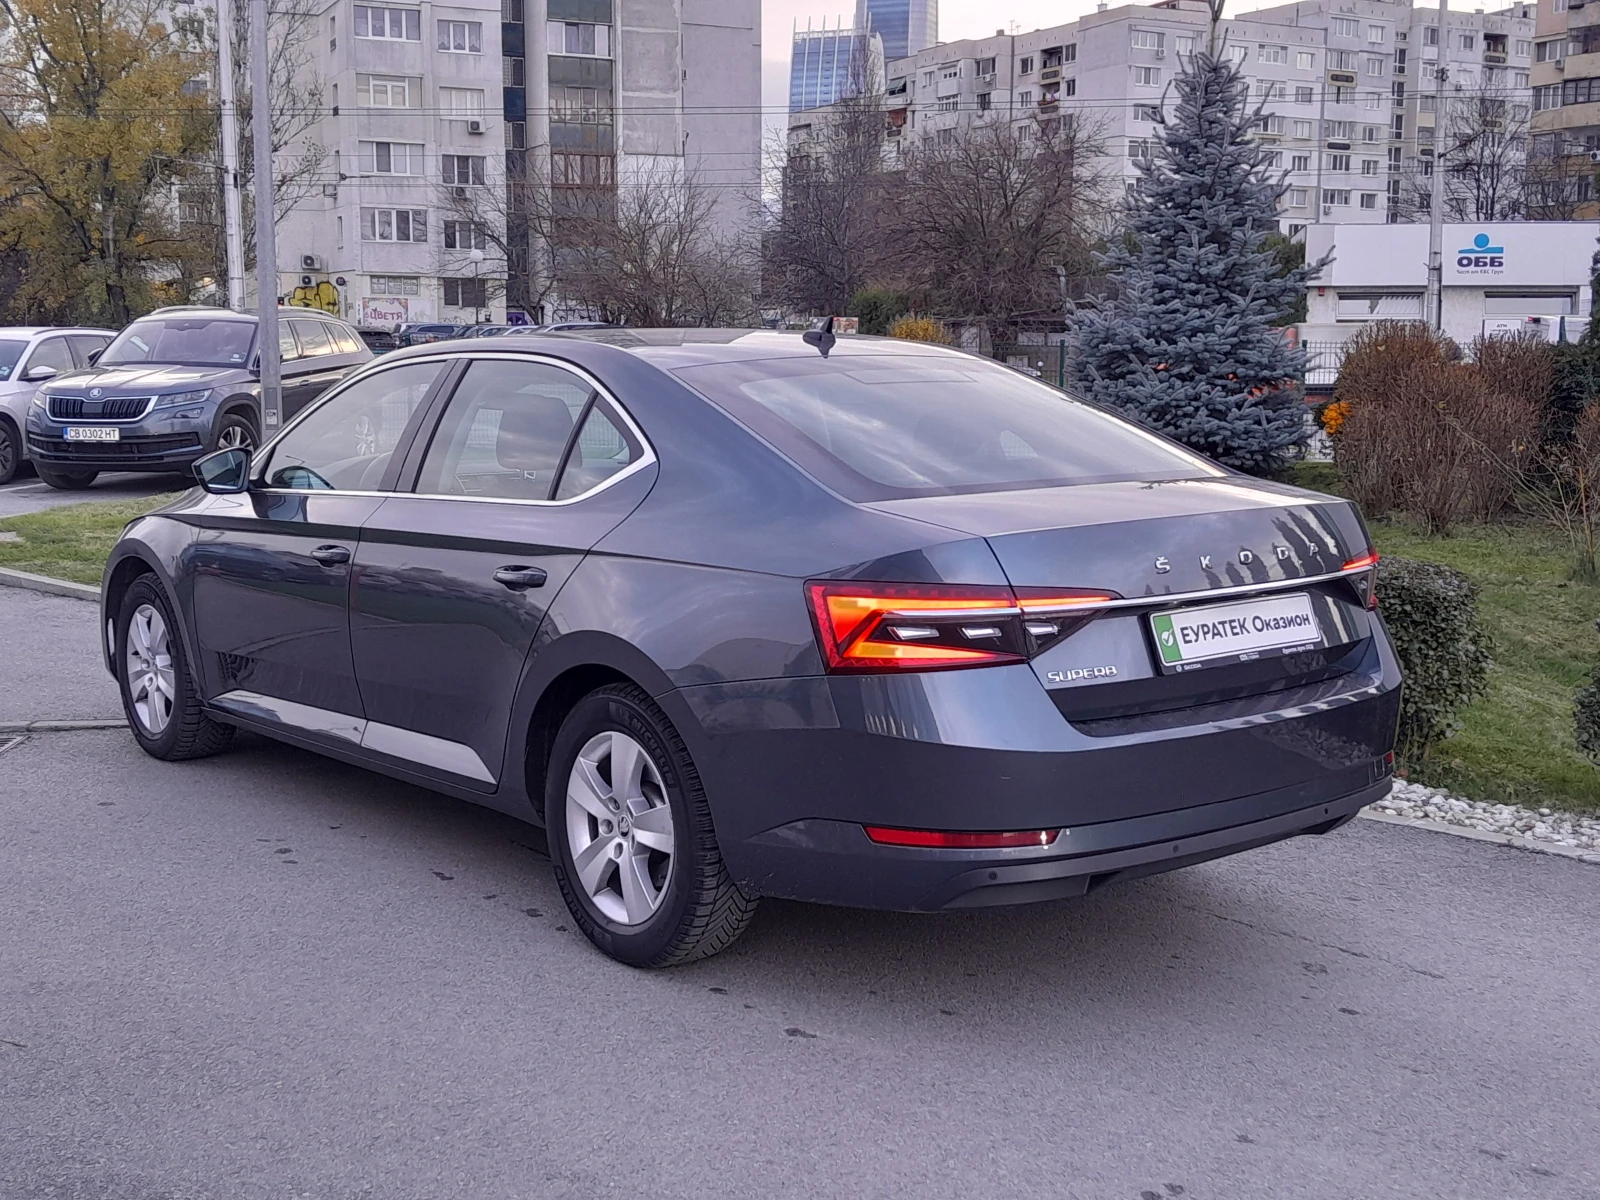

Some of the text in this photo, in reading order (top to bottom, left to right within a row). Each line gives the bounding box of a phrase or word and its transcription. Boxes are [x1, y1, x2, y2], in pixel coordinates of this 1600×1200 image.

[1457, 256, 1504, 268] ОББ
[370, 309, 403, 321] ЦВЕТЯ
[82, 428, 103, 439] 0302
[1155, 542, 1319, 574] ŠKODA
[1180, 613, 1311, 645] ЕУРАТЕК Оказион
[1047, 665, 1118, 683] SUPERB
[631, 718, 675, 785] MICHELIN
